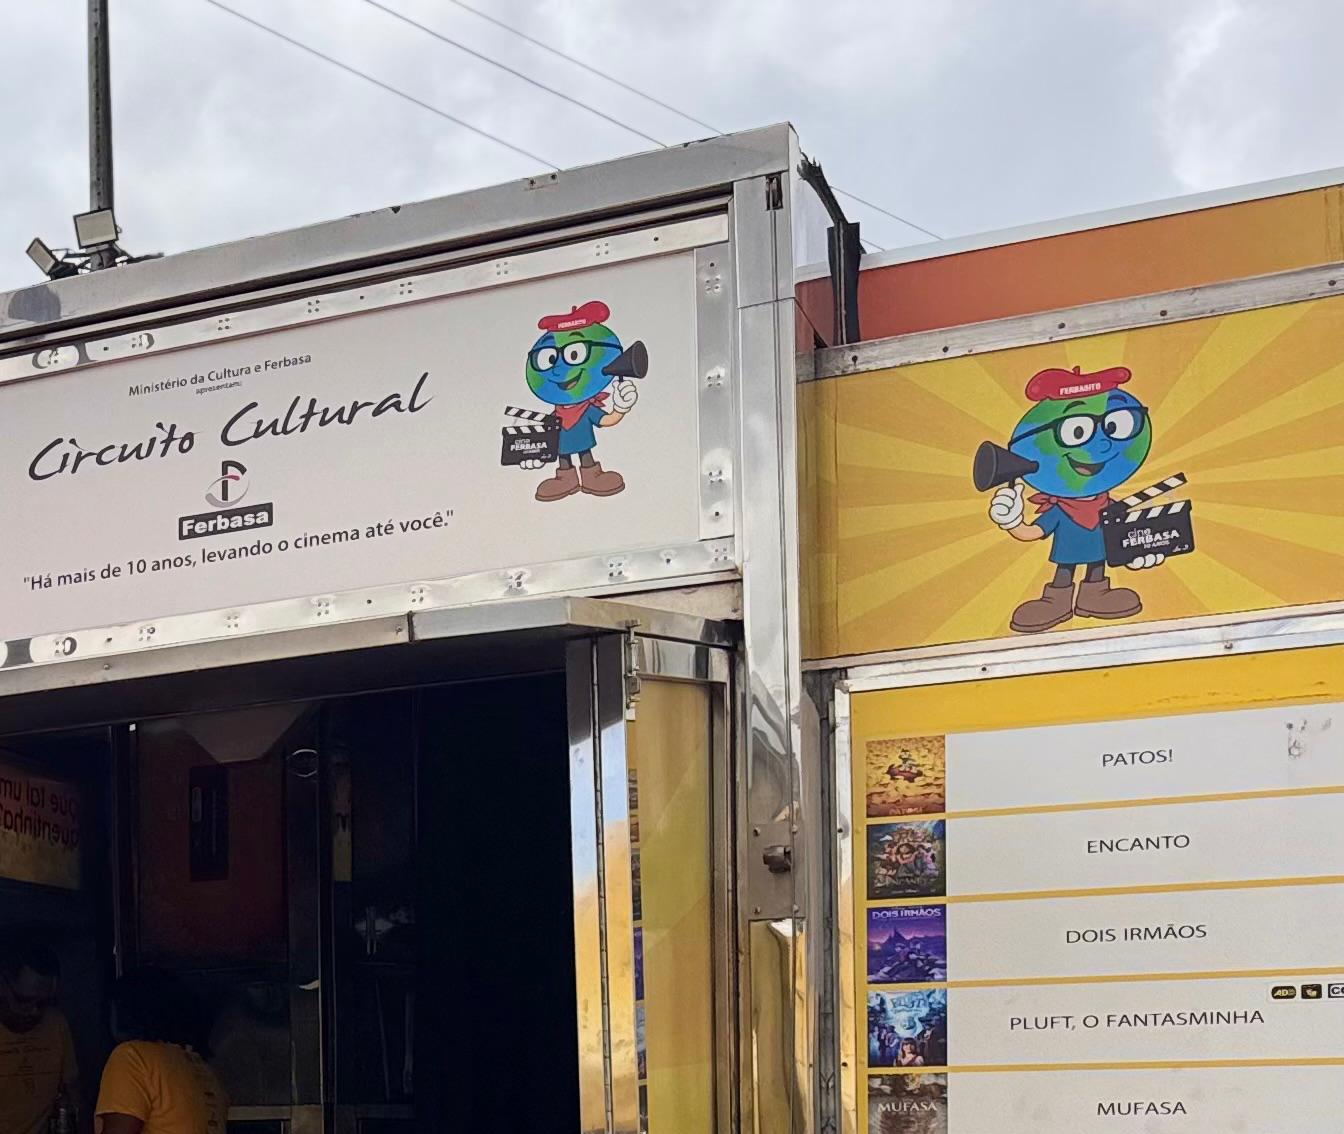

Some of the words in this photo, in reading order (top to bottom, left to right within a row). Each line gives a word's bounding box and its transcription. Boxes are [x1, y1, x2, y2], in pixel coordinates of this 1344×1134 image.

[128, 376, 188, 397] Ministério
[190, 373, 205, 386] da
[207, 365, 251, 383] Cultura
[254, 364, 262, 374] e
[264, 353, 312, 372] Ferbasa
[28, 422, 197, 482] Circuito
[220, 371, 433, 447] Cultural
[182, 508, 270, 537] Ferbasa
[1122, 530, 1180, 548] FERBASA
[23, 574, 53, 592] "Há
[57, 568, 96, 587] mais
[100, 563, 122, 581] de
[127, 559, 147, 576] 10
[150, 554, 198, 573] anos,
[201, 540, 274, 565] levando
[278, 540, 289, 552] o
[293, 528, 360, 549] cinema
[365, 519, 395, 540] até
[399, 510, 455, 534] você."
[1101, 749, 1174, 768] PATOS!
[1086, 834, 1191, 854] ENCANTO
[872, 911, 898, 919] DOIS
[1065, 927, 1117, 945] DOIS
[1124, 923, 1208, 941] IRMÃOS
[1009, 1015, 1076, 1031] PLUFT,
[1083, 1014, 1099, 1029] O
[1106, 1010, 1265, 1028] FANTASMINHA
[877, 1101, 938, 1113] MUFASA
[1096, 1101, 1188, 1116] MUFASA
